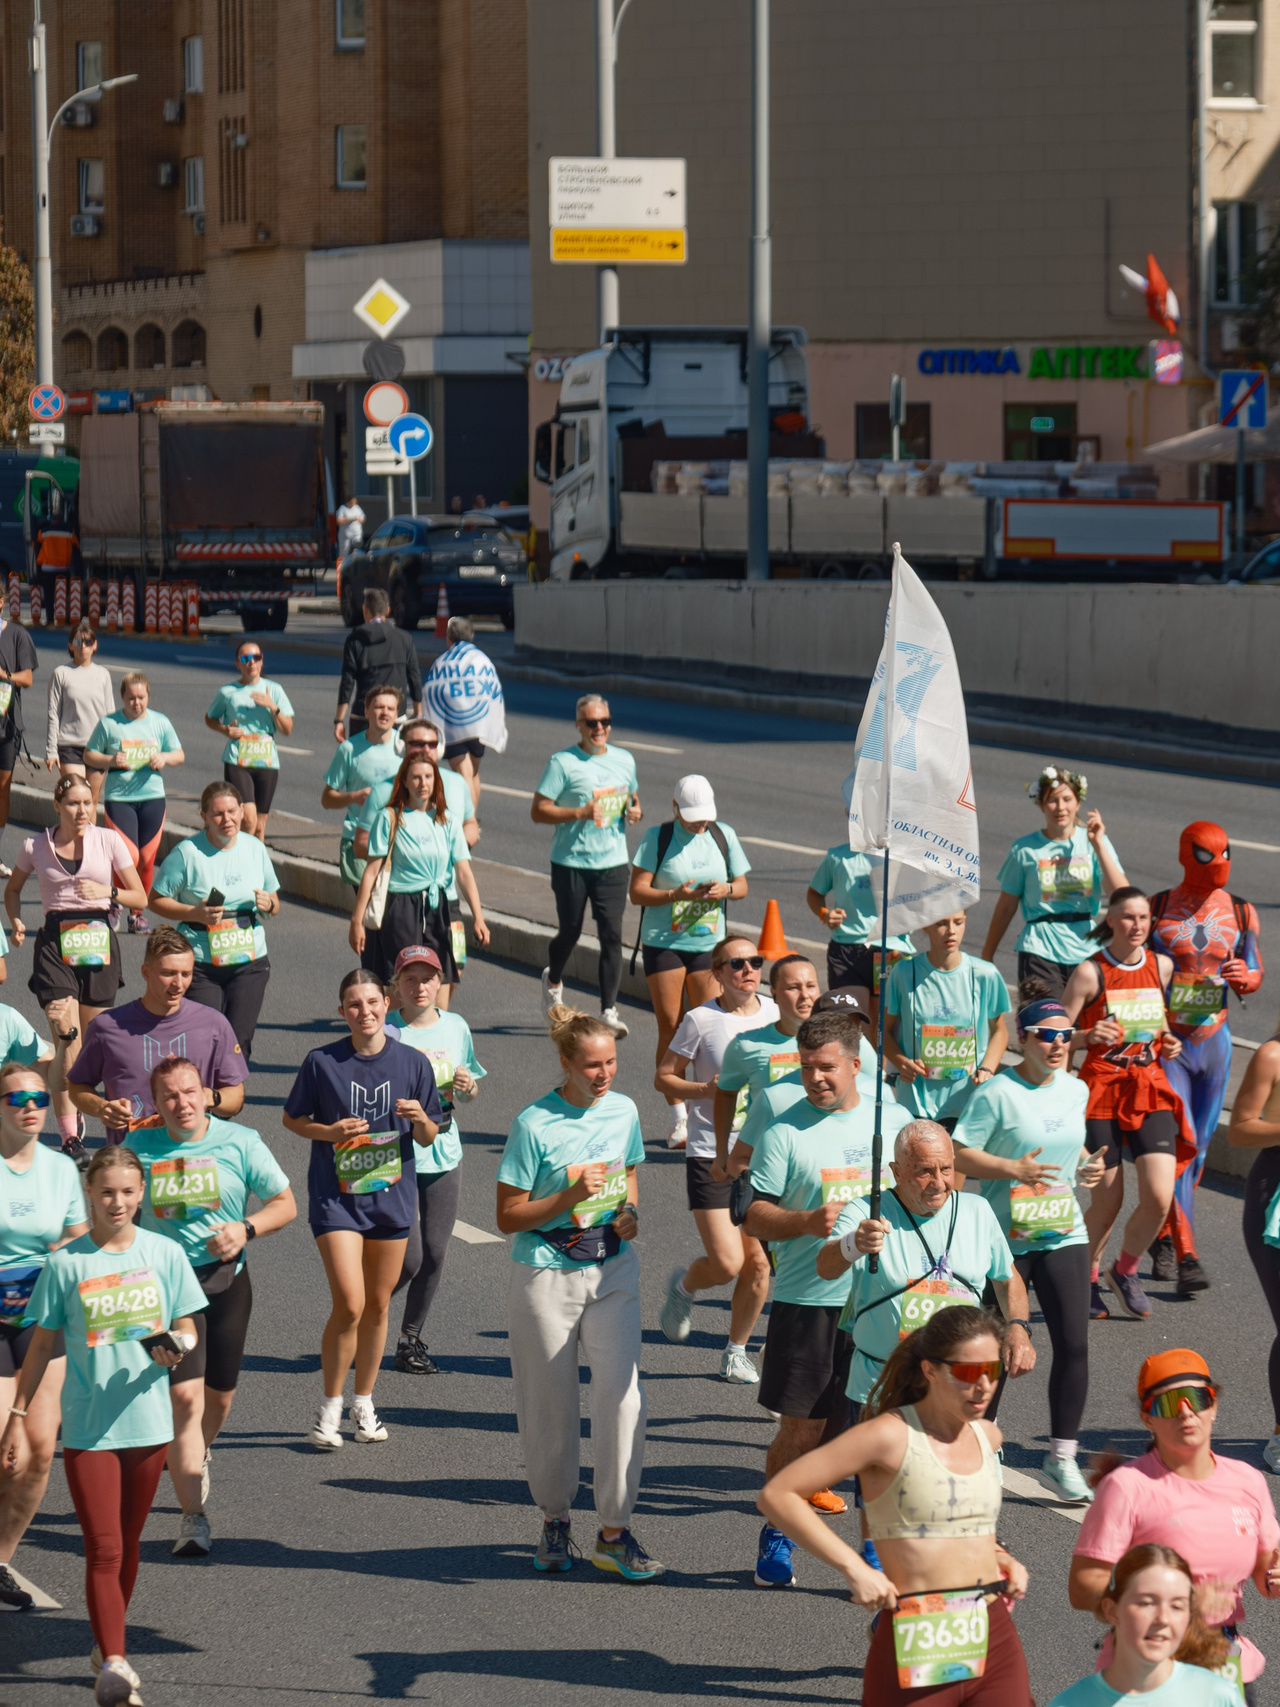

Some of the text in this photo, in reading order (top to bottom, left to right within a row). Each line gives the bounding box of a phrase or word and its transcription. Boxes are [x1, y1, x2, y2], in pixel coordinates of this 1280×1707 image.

[918, 348, 1020, 375] ОПТИКА
[1028, 347, 1150, 379] АПТЕК
[894, 820, 964, 856] ОБЛАСТНАЯ
[924, 850, 940, 864] им.
[63, 932, 107, 948] 65957
[211, 930, 253, 948] 65956
[1174, 987, 1222, 1005] 74659
[1110, 1003, 1162, 1022] 74655
[924, 1039, 976, 1058] 68462
[339, 1148, 398, 1171] 68898
[153, 1172, 215, 1198] 76231
[1014, 1198, 1071, 1222] 72487
[84, 1286, 159, 1319] 78428
[897, 1616, 986, 1652] 73630
